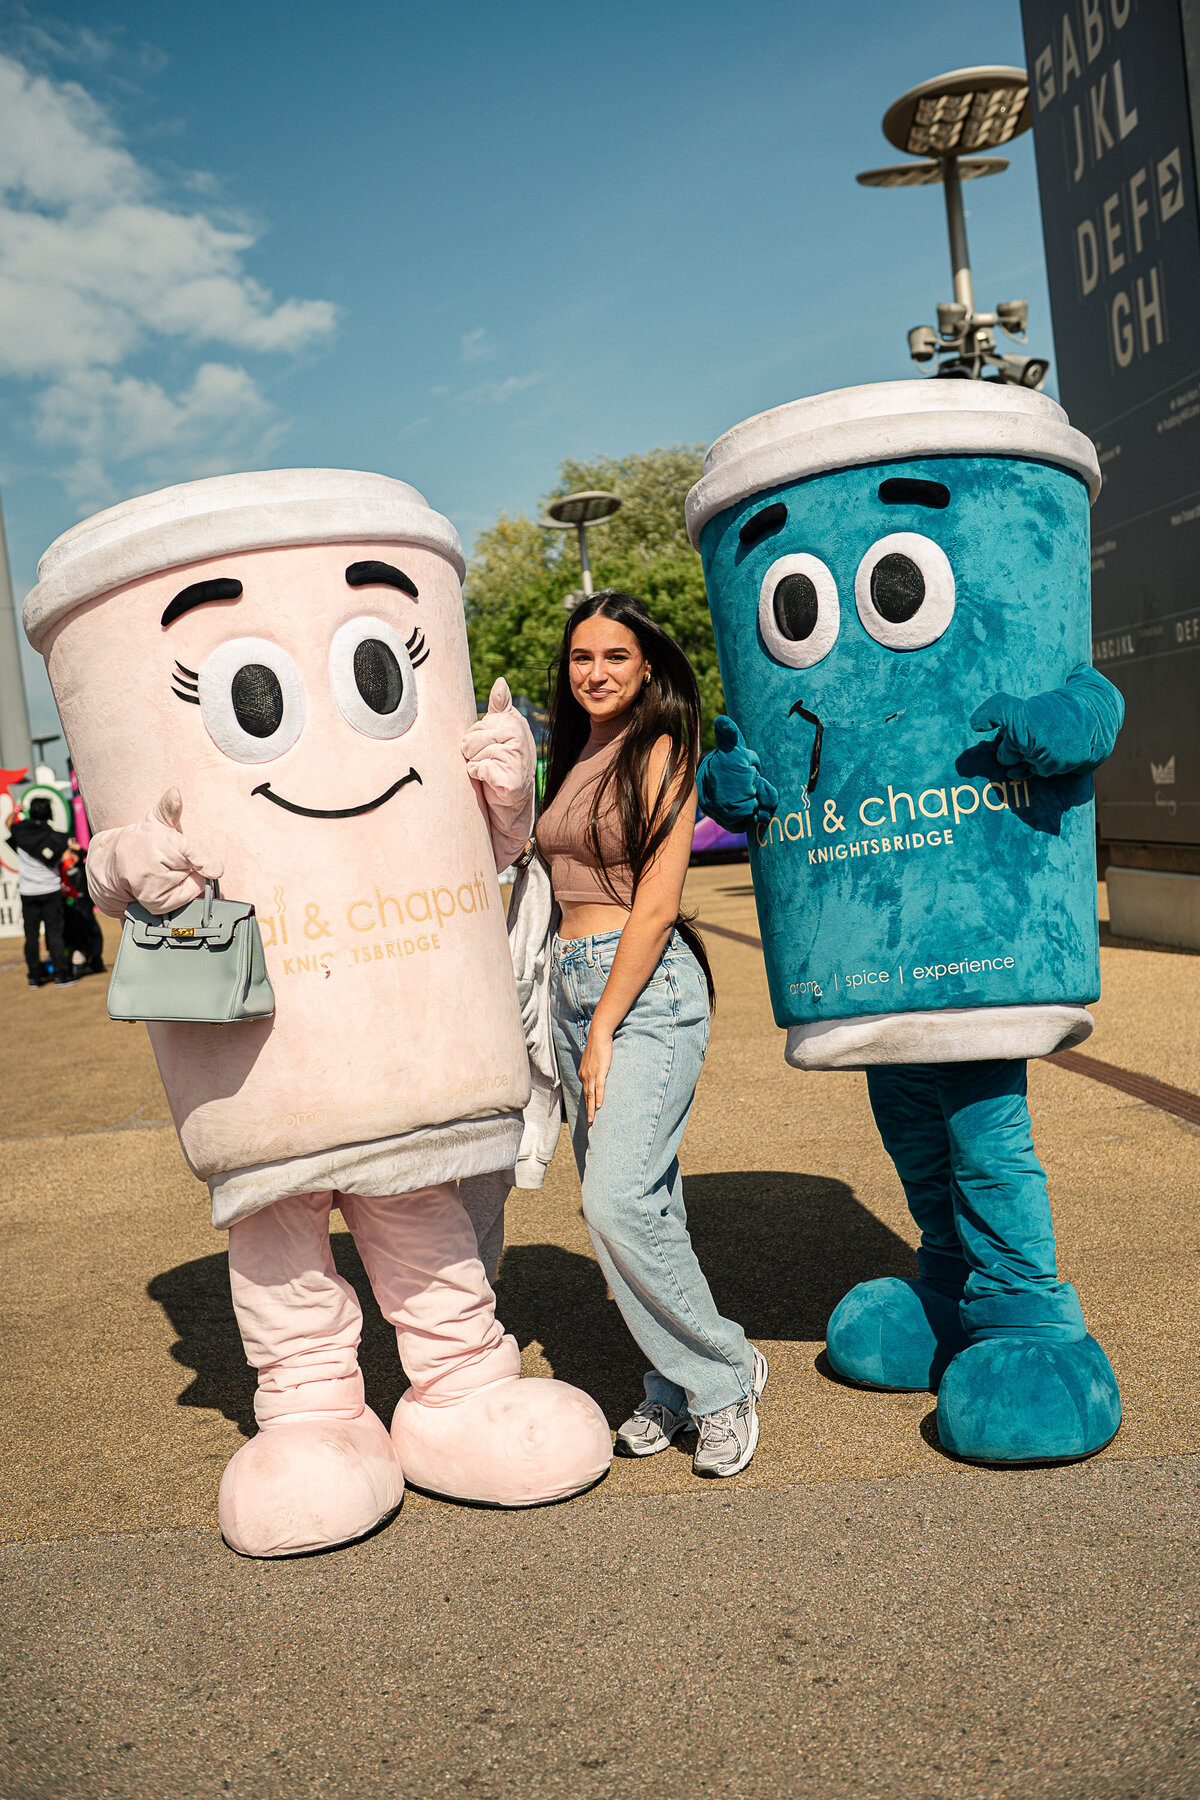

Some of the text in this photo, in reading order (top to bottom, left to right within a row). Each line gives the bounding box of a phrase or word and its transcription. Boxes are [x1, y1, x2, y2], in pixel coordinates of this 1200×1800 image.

[1073, 58, 1138, 183] JKL
[1076, 167, 1149, 297] DEF
[1111, 266, 1164, 368] GH
[822, 798, 847, 834] &
[807, 828, 954, 865] KNIGHTSBRIDGE
[303, 902, 334, 941] &
[346, 870, 490, 932] chapati
[283, 933, 441, 976] KNITSBRIDGE
[845, 968, 890, 990] spice
[912, 955, 1015, 980] experience
[353, 1095, 407, 1120] spice
